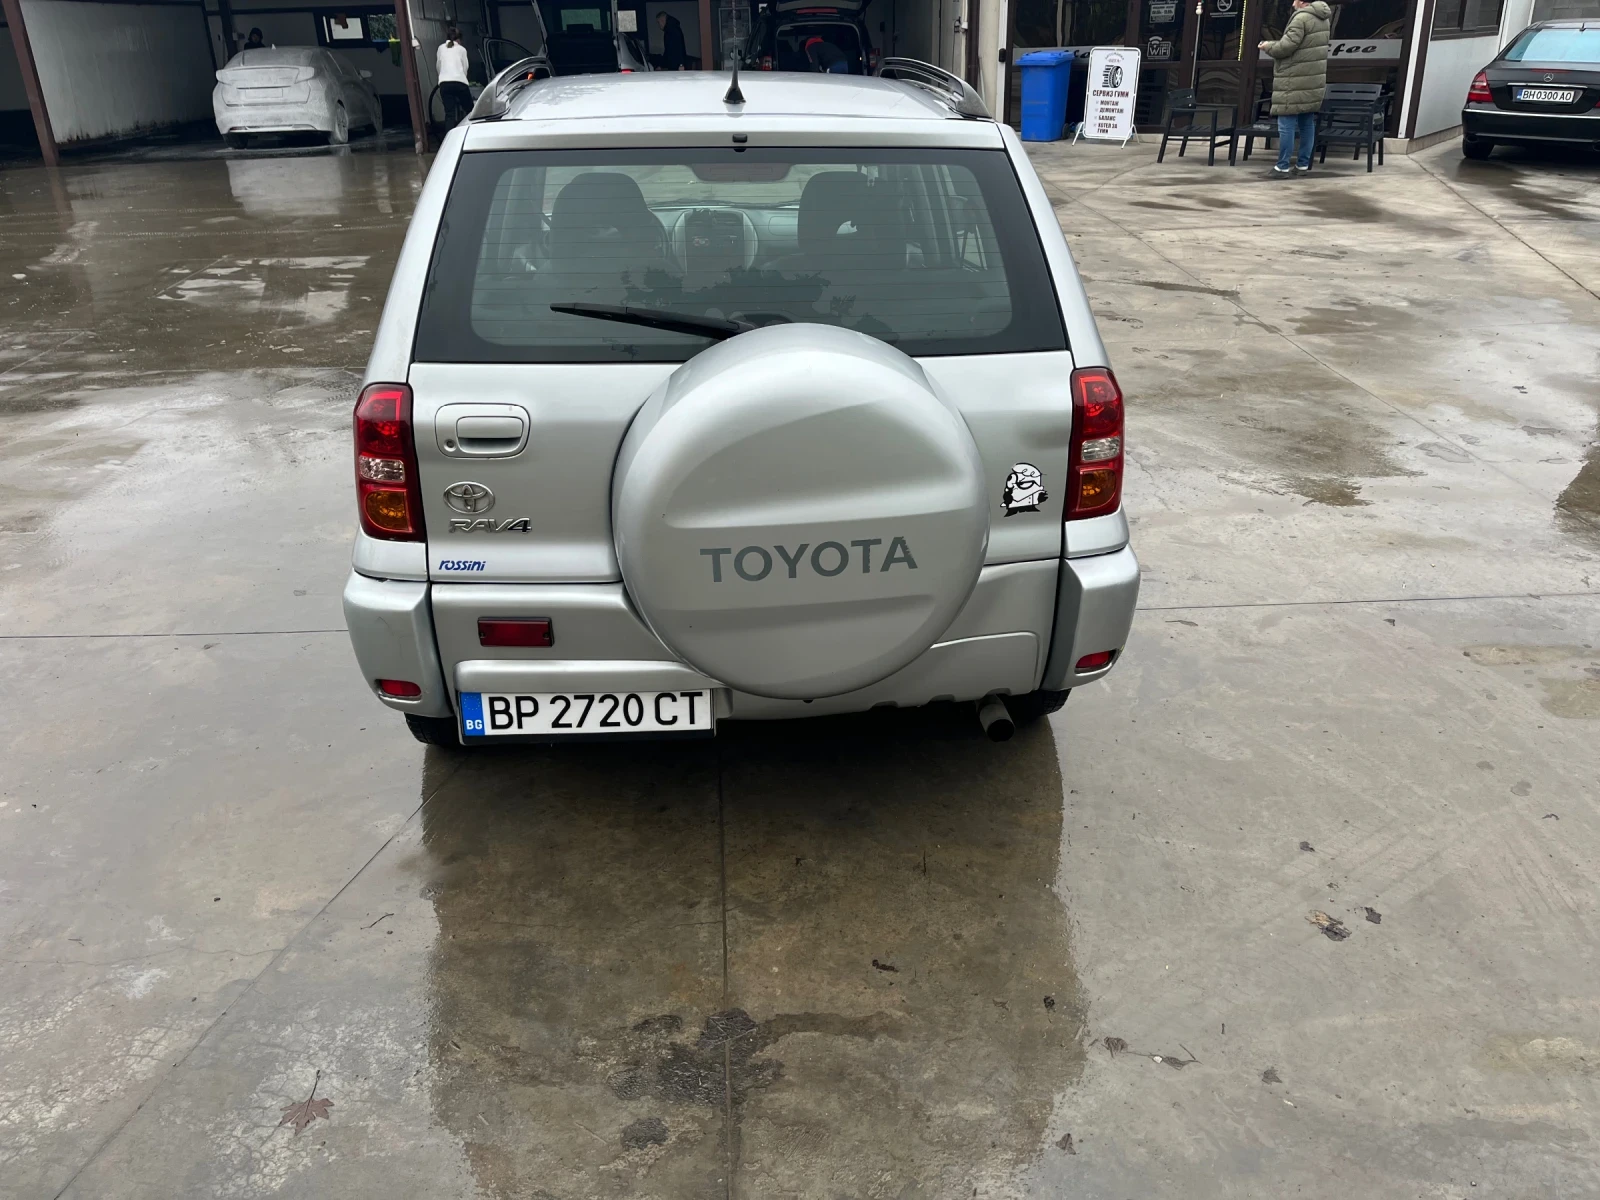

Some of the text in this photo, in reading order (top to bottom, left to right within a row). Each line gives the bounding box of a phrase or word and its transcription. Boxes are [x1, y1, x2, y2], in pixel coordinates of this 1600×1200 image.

[1522, 90, 1536, 99] BH
[1536, 91, 1558, 100] 0300
[448, 517, 532, 533] RAV4
[438, 560, 486, 571] rossini
[699, 536, 918, 583] TOYOTA
[488, 691, 703, 730] BP 2720 CT
[466, 719, 483, 730] BG
